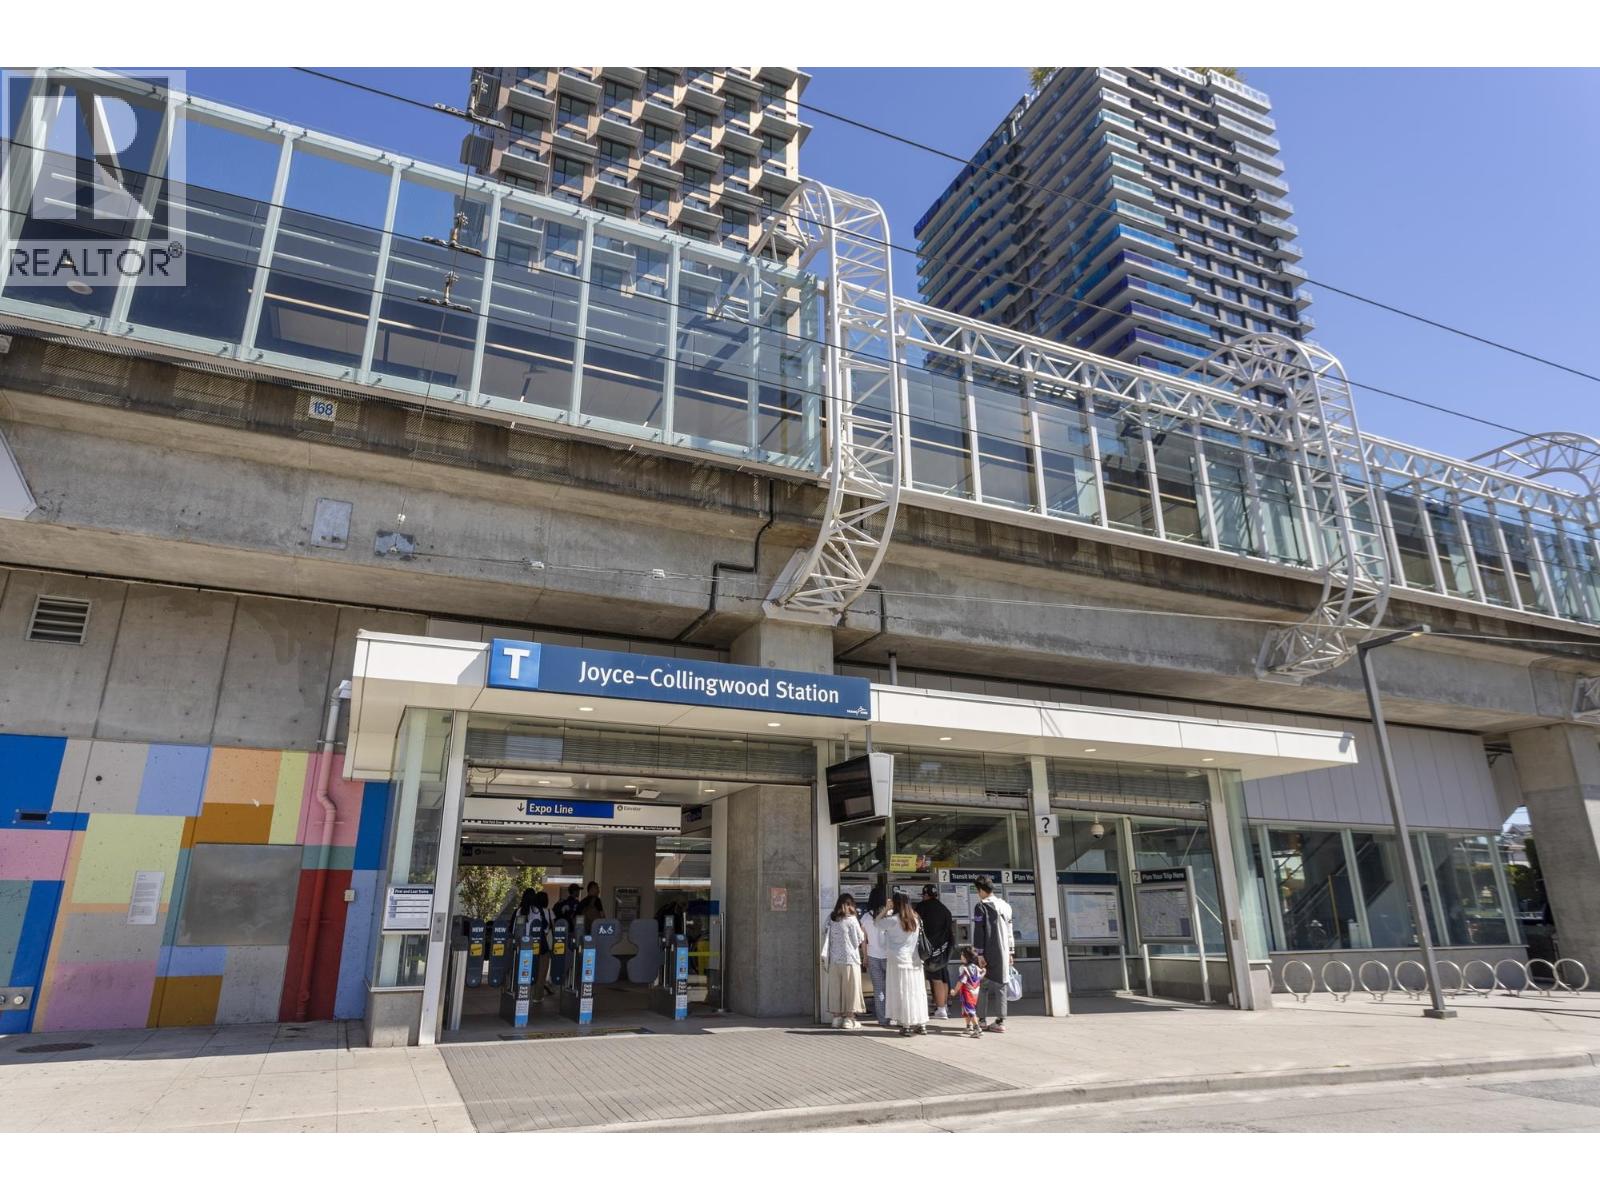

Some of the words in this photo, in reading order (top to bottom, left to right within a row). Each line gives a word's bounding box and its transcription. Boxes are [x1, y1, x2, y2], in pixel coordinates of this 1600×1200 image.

[313, 401, 333, 416] 168
[503, 647, 531, 680] T
[775, 680, 840, 704] Station
[529, 803, 552, 815] Expo
[554, 804, 574, 815] Line
[951, 872, 967, 880] Transit
[1014, 873, 1024, 881] Plan
